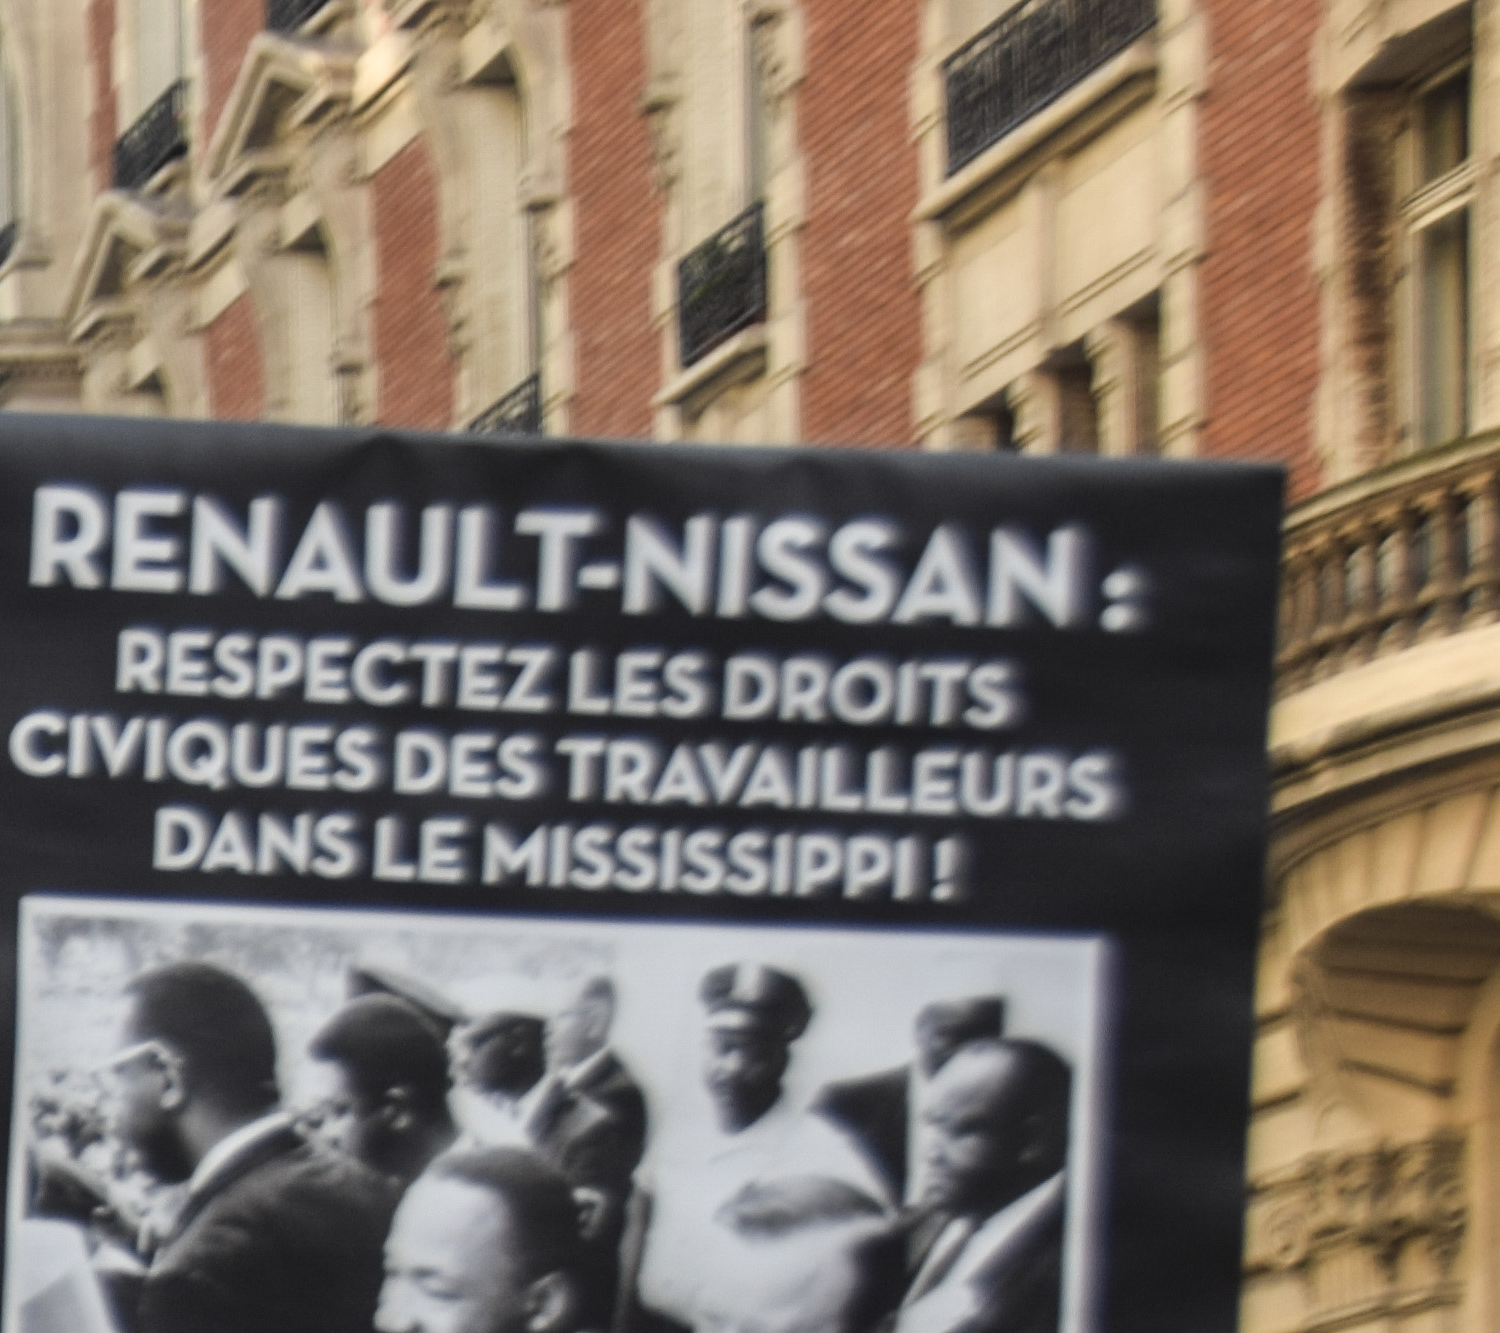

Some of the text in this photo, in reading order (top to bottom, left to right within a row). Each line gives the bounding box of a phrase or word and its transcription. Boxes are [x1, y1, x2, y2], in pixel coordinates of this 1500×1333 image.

[113, 627, 1015, 731] RESPECTEZ LES DROITS
[8, 710, 1118, 822] CIVIQUES DES TRAVAILLEURS
[153, 804, 357, 878] DANS
[371, 813, 469, 883] LE
